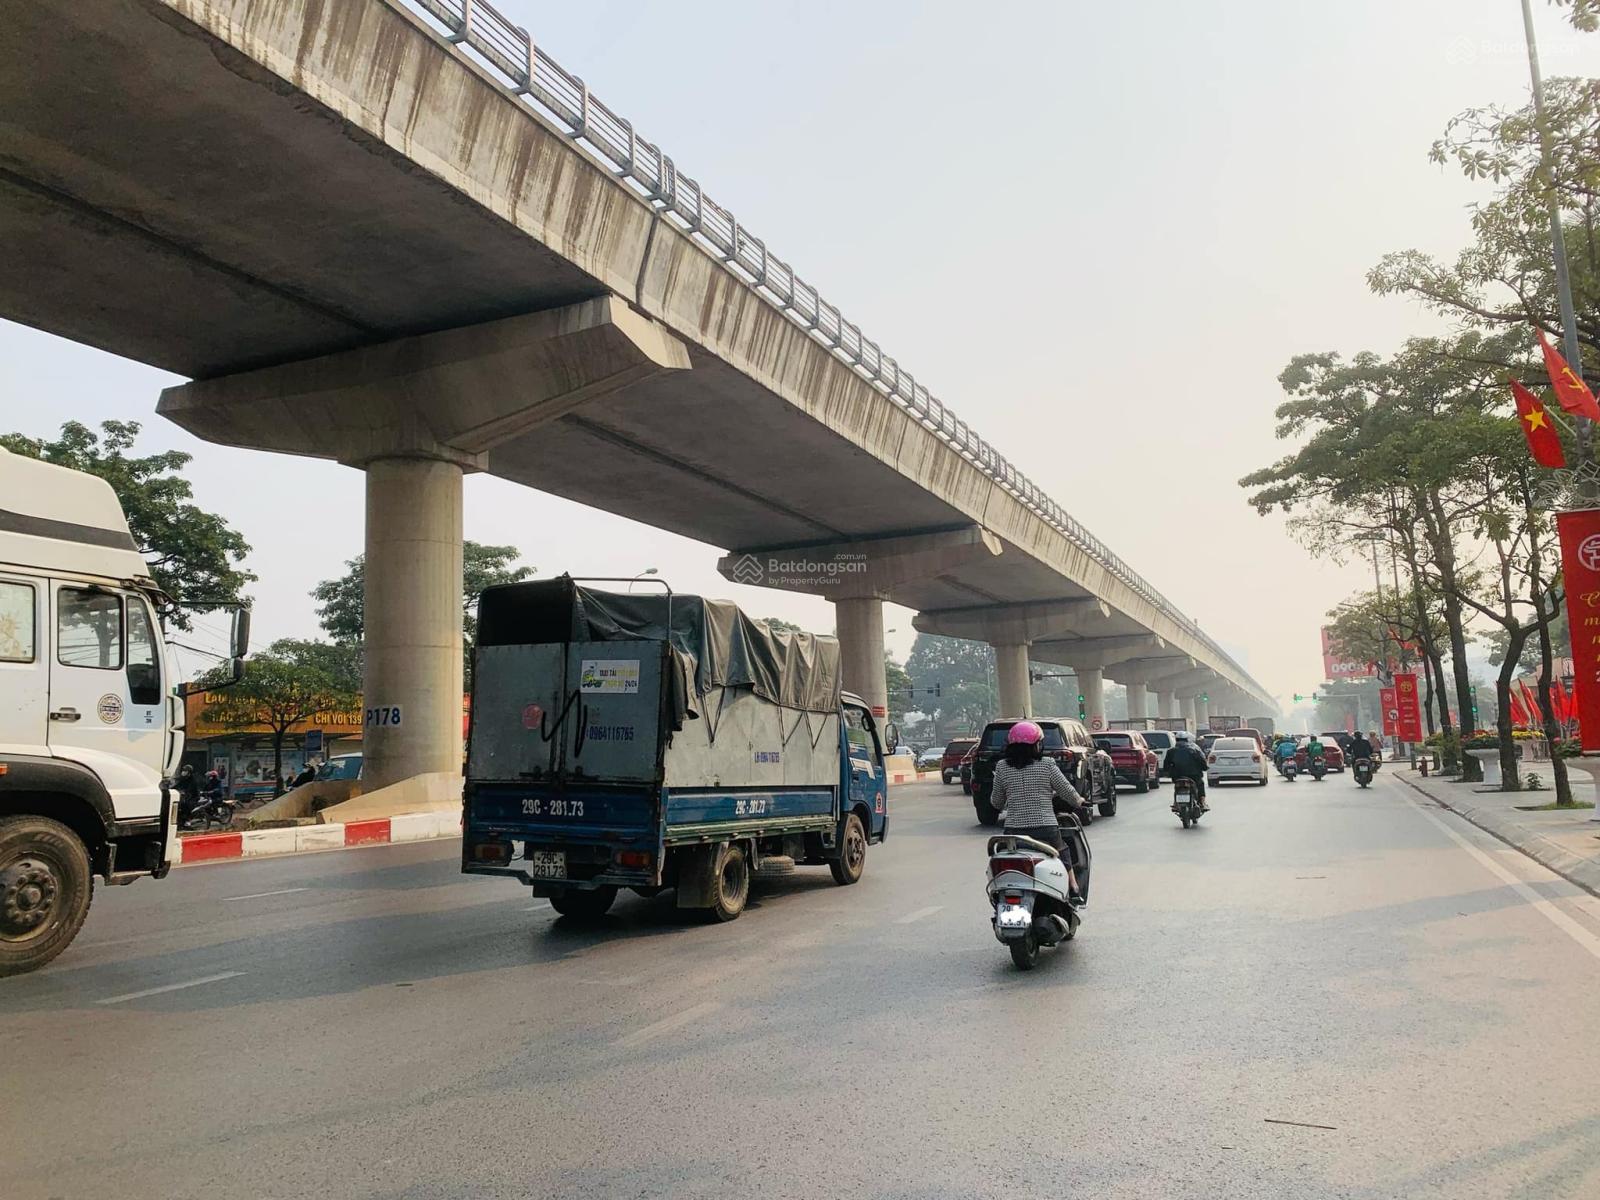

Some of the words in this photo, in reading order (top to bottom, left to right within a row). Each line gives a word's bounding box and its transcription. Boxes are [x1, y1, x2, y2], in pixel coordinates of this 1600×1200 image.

[364, 707, 400, 729] P178
[522, 799, 540, 814] 29C
[549, 800, 584, 816] 281.73
